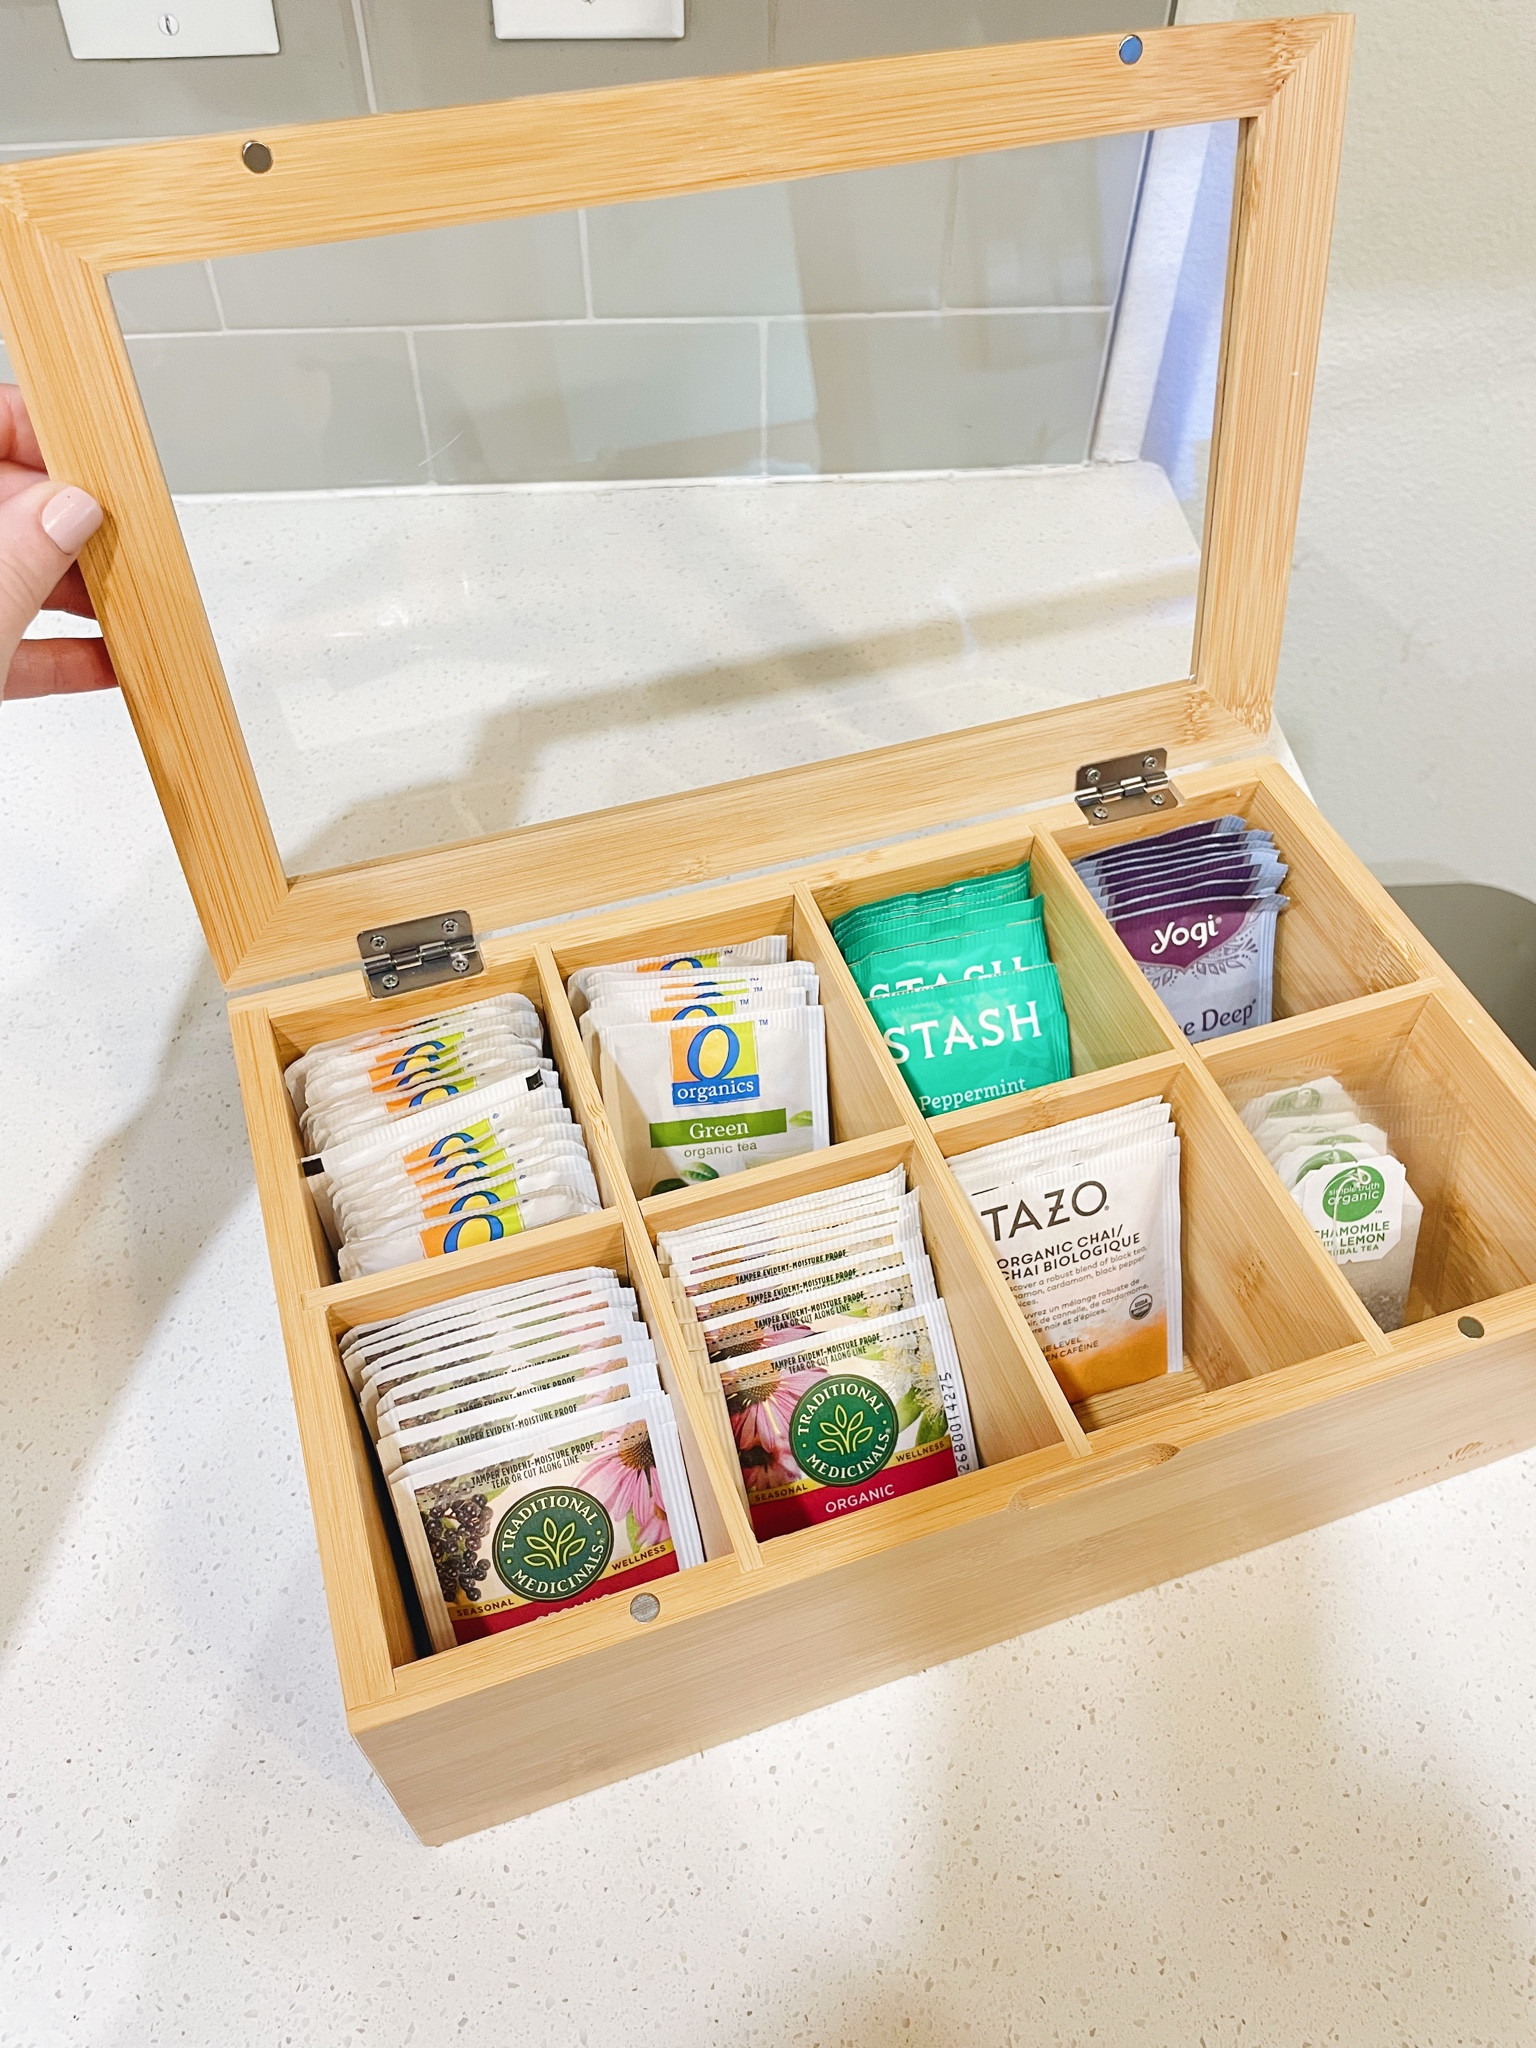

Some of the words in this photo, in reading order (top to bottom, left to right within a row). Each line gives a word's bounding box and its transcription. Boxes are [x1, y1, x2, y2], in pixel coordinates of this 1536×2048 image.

[1150, 914, 1219, 955] yogi
[883, 1000, 1042, 1065] STASH
[1201, 1004, 1253, 1032] Deep
[687, 1024, 741, 1082] O
[677, 1079, 755, 1103] organics
[919, 1077, 1027, 1112] Peppermint
[689, 1120, 750, 1140] Green
[684, 1144, 734, 1159] organic
[737, 1141, 758, 1153] tea
[980, 1180, 1108, 1242] TAZO
[1327, 1190, 1380, 1206] organic
[997, 1241, 1073, 1270] ORGANIC
[1077, 1224, 1124, 1248] CHAI/
[1315, 1221, 1390, 1239] HAMOMILE
[1340, 1232, 1385, 1248] LEMON
[1001, 1265, 1039, 1281] CHAI
[1044, 1232, 1141, 1273] BIOLOGIQUE
[1361, 1244, 1379, 1252] TEA
[736, 1271, 762, 1284] TAMPER
[825, 1249, 847, 1260] PROOF
[1039, 1278, 1044, 1286] a
[1046, 1269, 1074, 1284] robust
[1075, 1262, 1098, 1277] blend
[1099, 1256, 1110, 1267] of
[1110, 1251, 1132, 1263] black
[1046, 1274, 1094, 1293] cardamom,
[1095, 1265, 1117, 1278] black
[1118, 1254, 1147, 1271] pepper
[746, 1291, 772, 1304] TAMPER
[773, 1275, 834, 1297] EVIDENT-MOISTURE
[835, 1268, 857, 1281] PROOF
[1049, 1305, 1060, 1314] un
[1061, 1294, 1097, 1309] mélange
[1098, 1283, 1129, 1298] robuste
[1130, 1279, 1140, 1287] de
[754, 1315, 780, 1329] TAMPER
[781, 1299, 842, 1321] EVIDENT-MOISTURE
[843, 1290, 865, 1303] PROOF
[772, 1321, 789, 1332] TEAR
[790, 1318, 800, 1327] OR
[800, 1315, 813, 1324] CUT
[814, 1308, 836, 1321] ALONG
[836, 1303, 851, 1314] LINE
[1040, 1315, 1051, 1325] de
[1089, 1301, 1100, 1309] de
[1062, 1318, 1072, 1326] et
[770, 1358, 796, 1371] TAMPER
[797, 1340, 858, 1363] EVIDENT-MOISTURE
[859, 1333, 881, 1345] PROOF
[788, 1363, 806, 1375] TEAR
[806, 1360, 816, 1369] OR
[816, 1357, 829, 1367] CUT
[830, 1350, 851, 1363] ALONG
[852, 1345, 867, 1357] LINE
[1053, 1337, 1082, 1349] LEVEL
[1060, 1340, 1099, 1357] CAFÉINE
[455, 1429, 484, 1446] TAMPER
[486, 1411, 554, 1437] EVIDENT-MOISTURE
[554, 1403, 578, 1419] PROOF
[797, 1383, 885, 1436] TRADITIONAL
[470, 1469, 500, 1486] TAMPER
[501, 1448, 570, 1476] EVIDENT-MOISTURE
[571, 1440, 595, 1455] PROOF
[806, 1432, 890, 1479] MEDICINALS
[895, 1440, 945, 1463] WELLNESS
[490, 1478, 511, 1490] TEAR
[511, 1473, 522, 1483] OR
[523, 1468, 537, 1480] CUT
[539, 1461, 563, 1474] ALONG
[564, 1454, 580, 1467] LINE
[754, 1483, 808, 1501] SEASONAL
[825, 1483, 896, 1514] ORGANIC
[501, 1495, 599, 1552] TRADITIONAL
[511, 1544, 605, 1595] MEDICINALS
[611, 1544, 667, 1571] WELLNESS
[456, 1598, 515, 1617] SEASONAL
